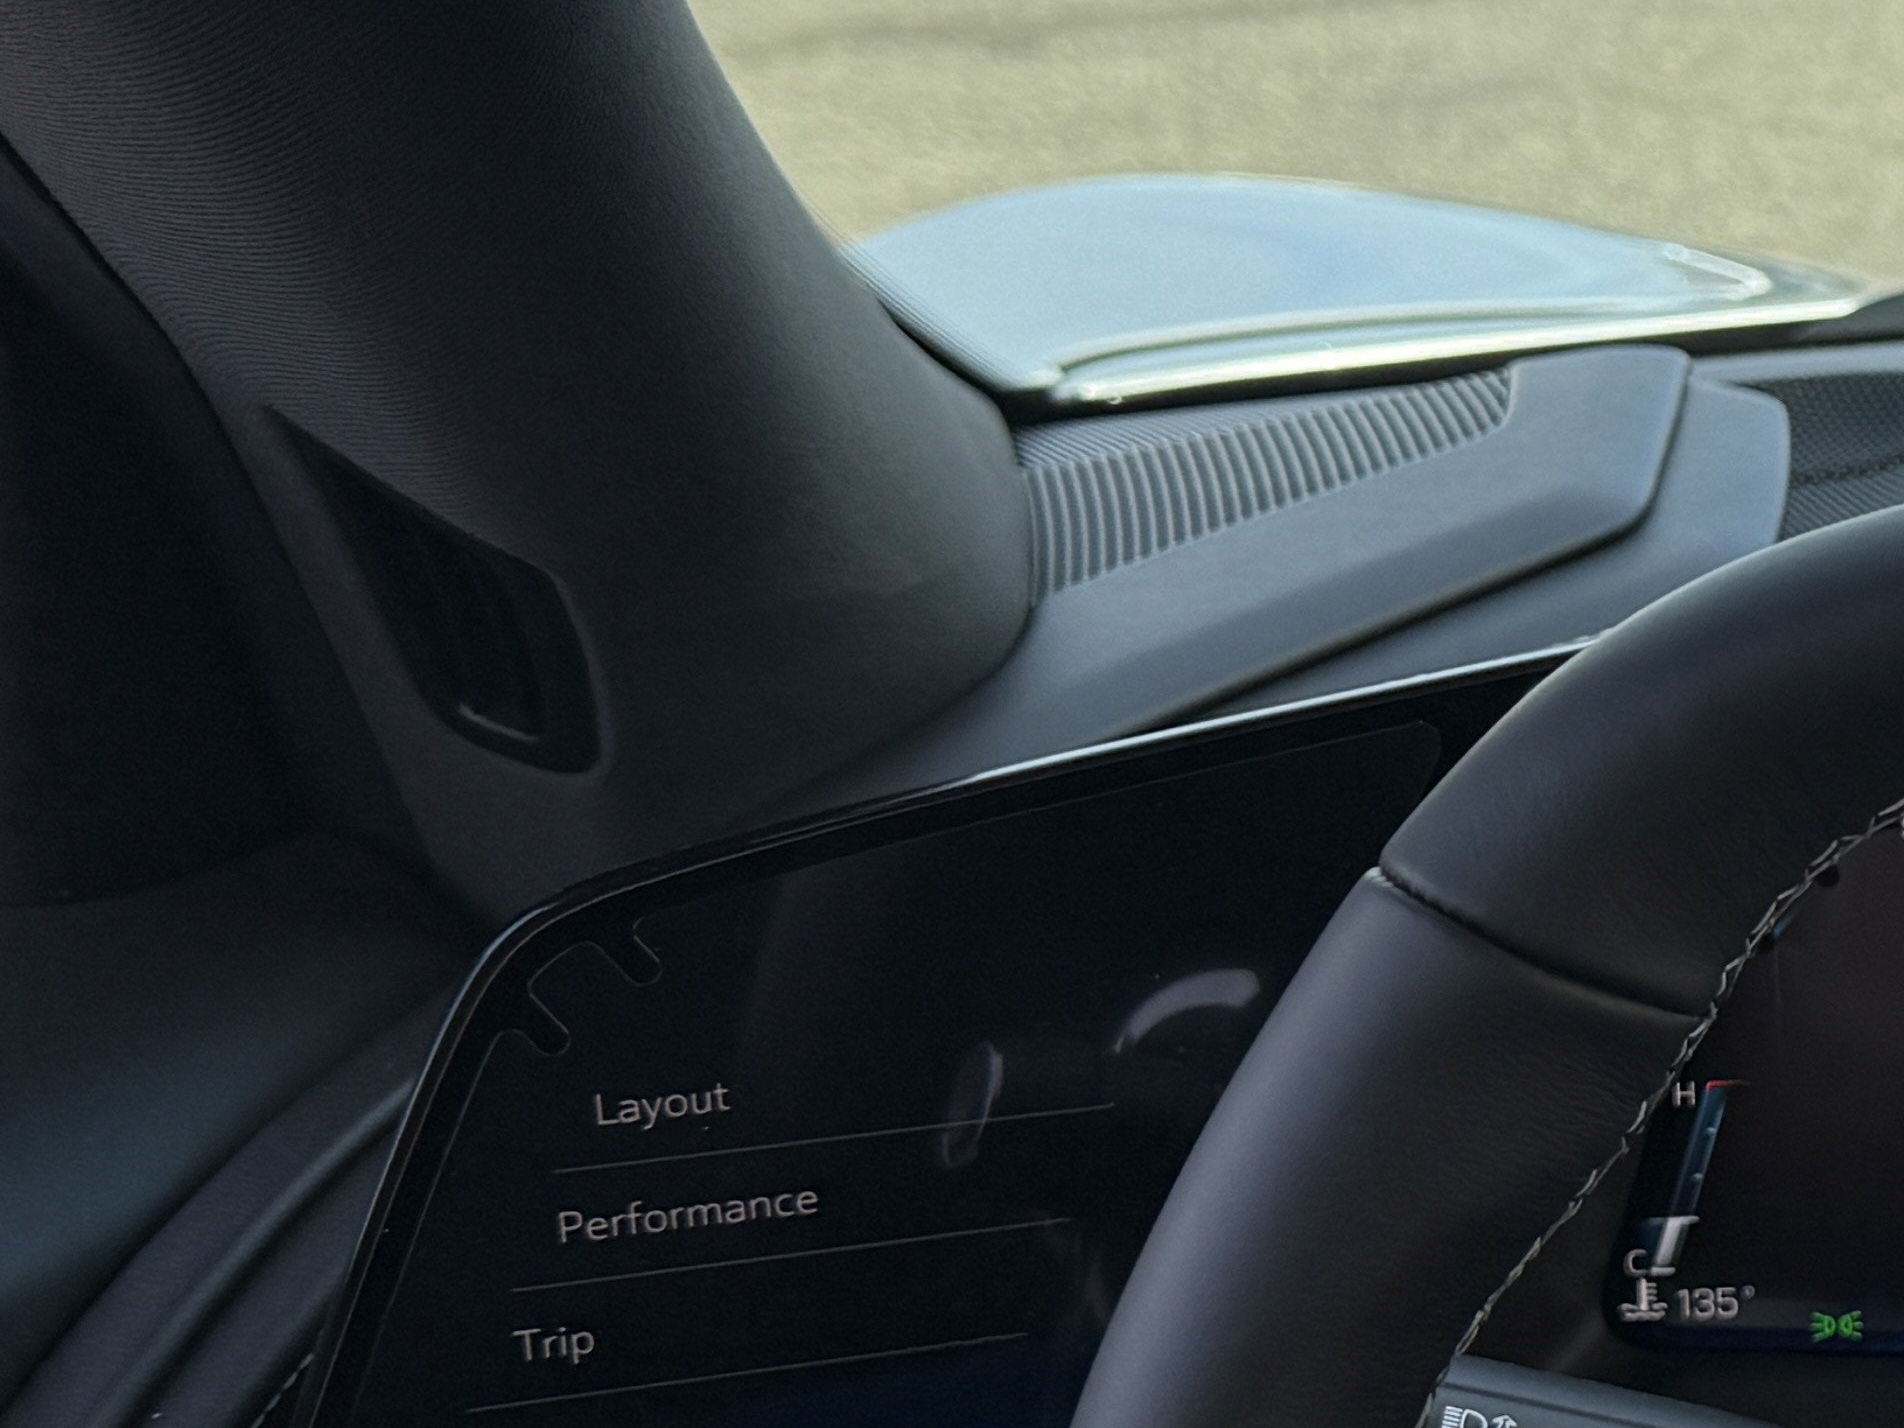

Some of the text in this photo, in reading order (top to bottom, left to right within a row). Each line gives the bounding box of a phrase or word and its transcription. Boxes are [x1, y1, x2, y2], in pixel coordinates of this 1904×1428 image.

[594, 1080, 732, 1132] Layout
[1672, 1081, 1696, 1107] H
[558, 1186, 820, 1244] Performance
[1623, 1250, 1646, 1274] C
[1674, 1286, 1755, 1320] 135°
[513, 1324, 596, 1368] Trip
